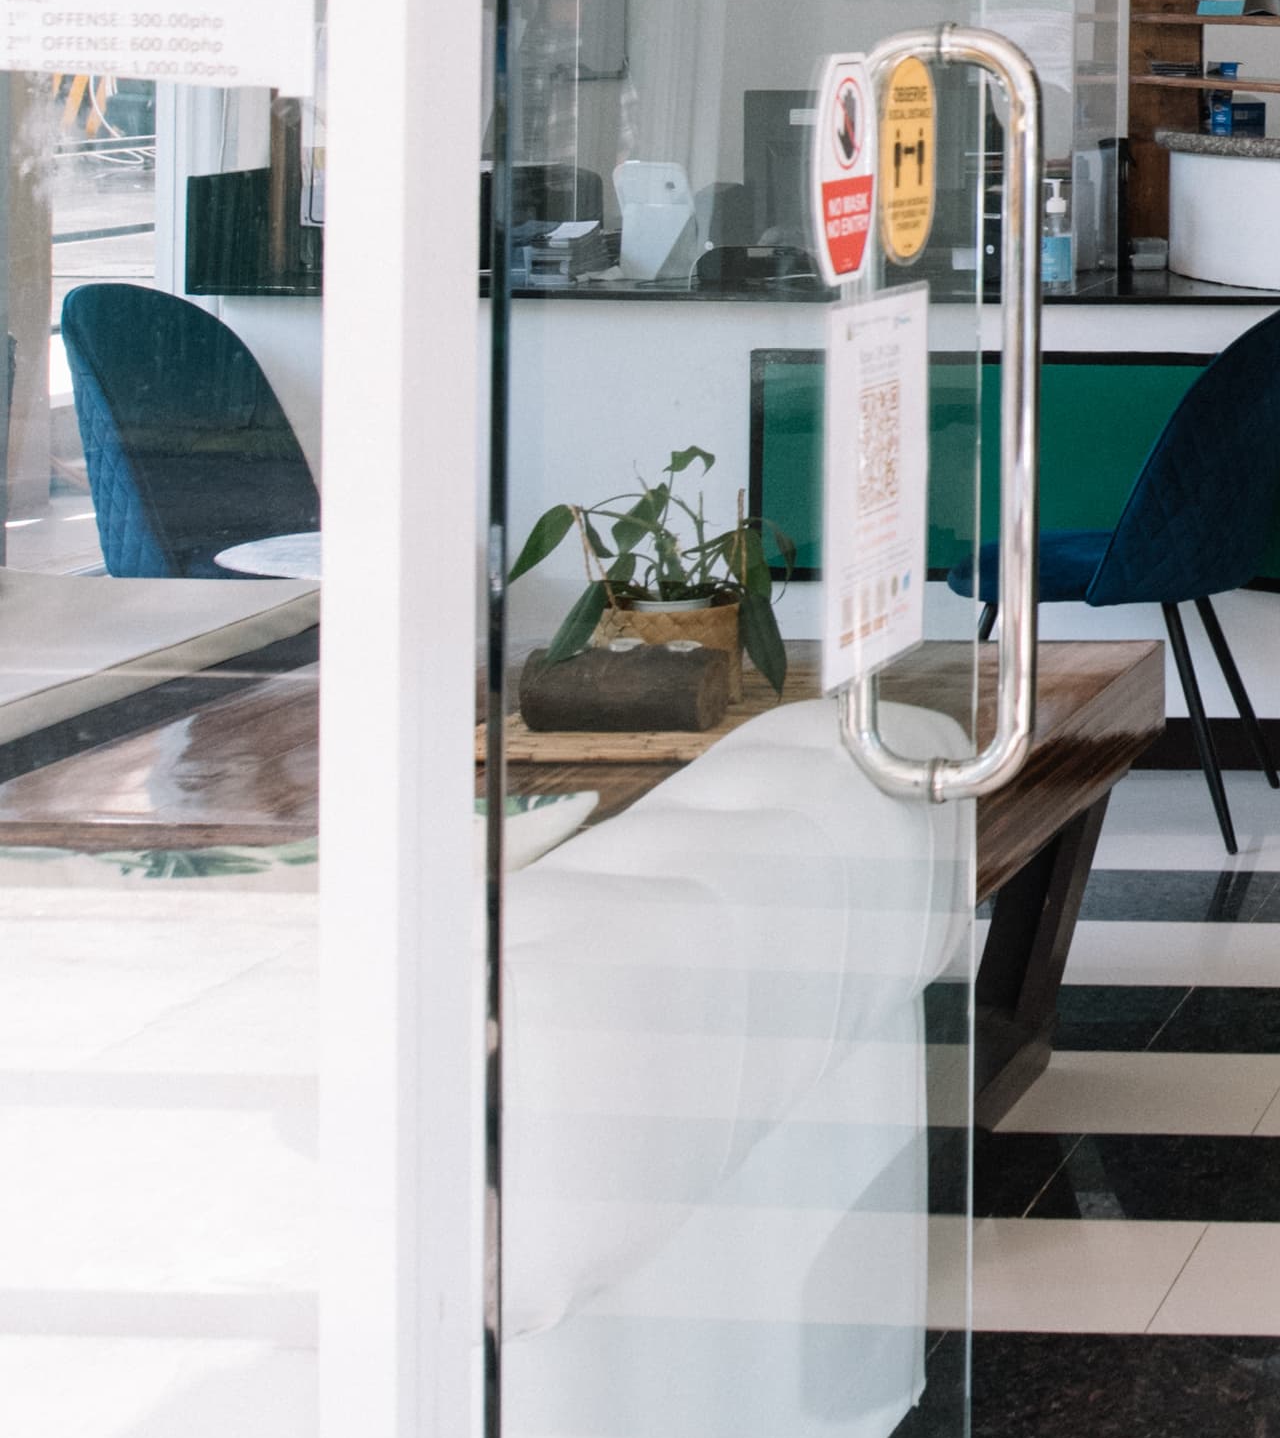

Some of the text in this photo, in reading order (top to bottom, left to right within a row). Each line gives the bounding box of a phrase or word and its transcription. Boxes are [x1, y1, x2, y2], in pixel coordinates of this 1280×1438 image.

[829, 197, 841, 216] NO
[843, 193, 869, 213] MASK
[827, 220, 840, 238] NO
